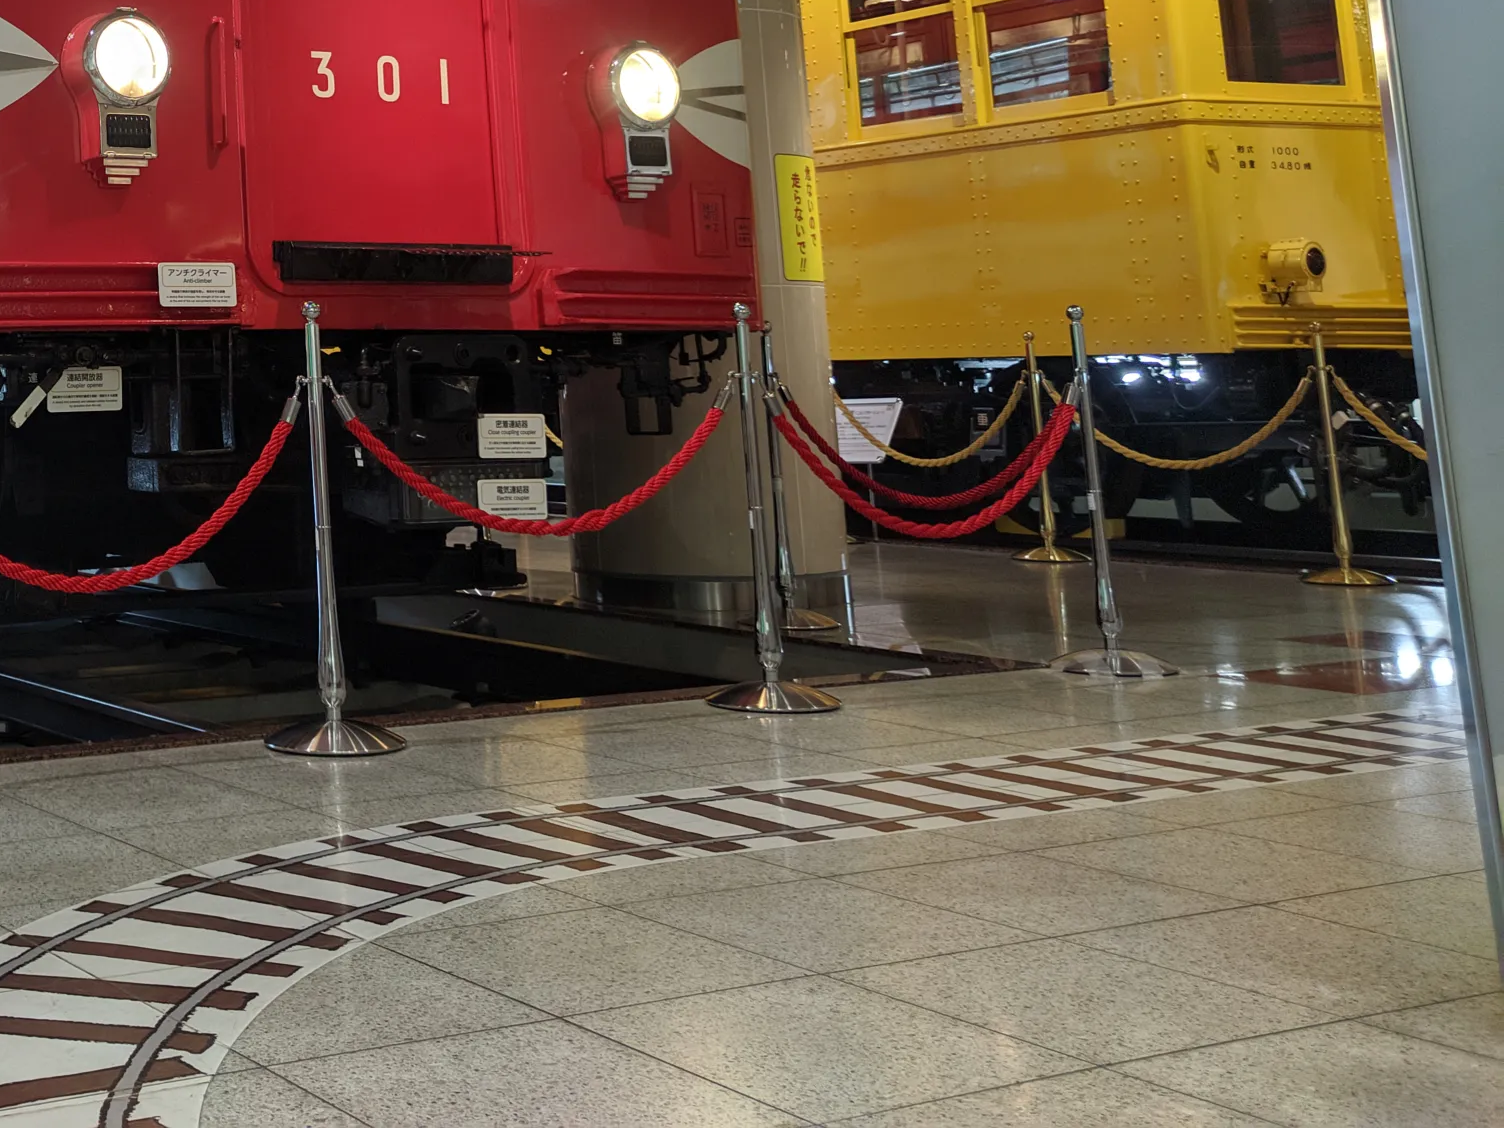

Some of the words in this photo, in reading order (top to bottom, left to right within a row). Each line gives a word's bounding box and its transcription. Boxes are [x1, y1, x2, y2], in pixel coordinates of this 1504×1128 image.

[310, 50, 450, 105] 301
[1271, 146, 1300, 156] 1000
[167, 268, 228, 277] アンチクライマー
[66, 372, 103, 382] 連結開放器
